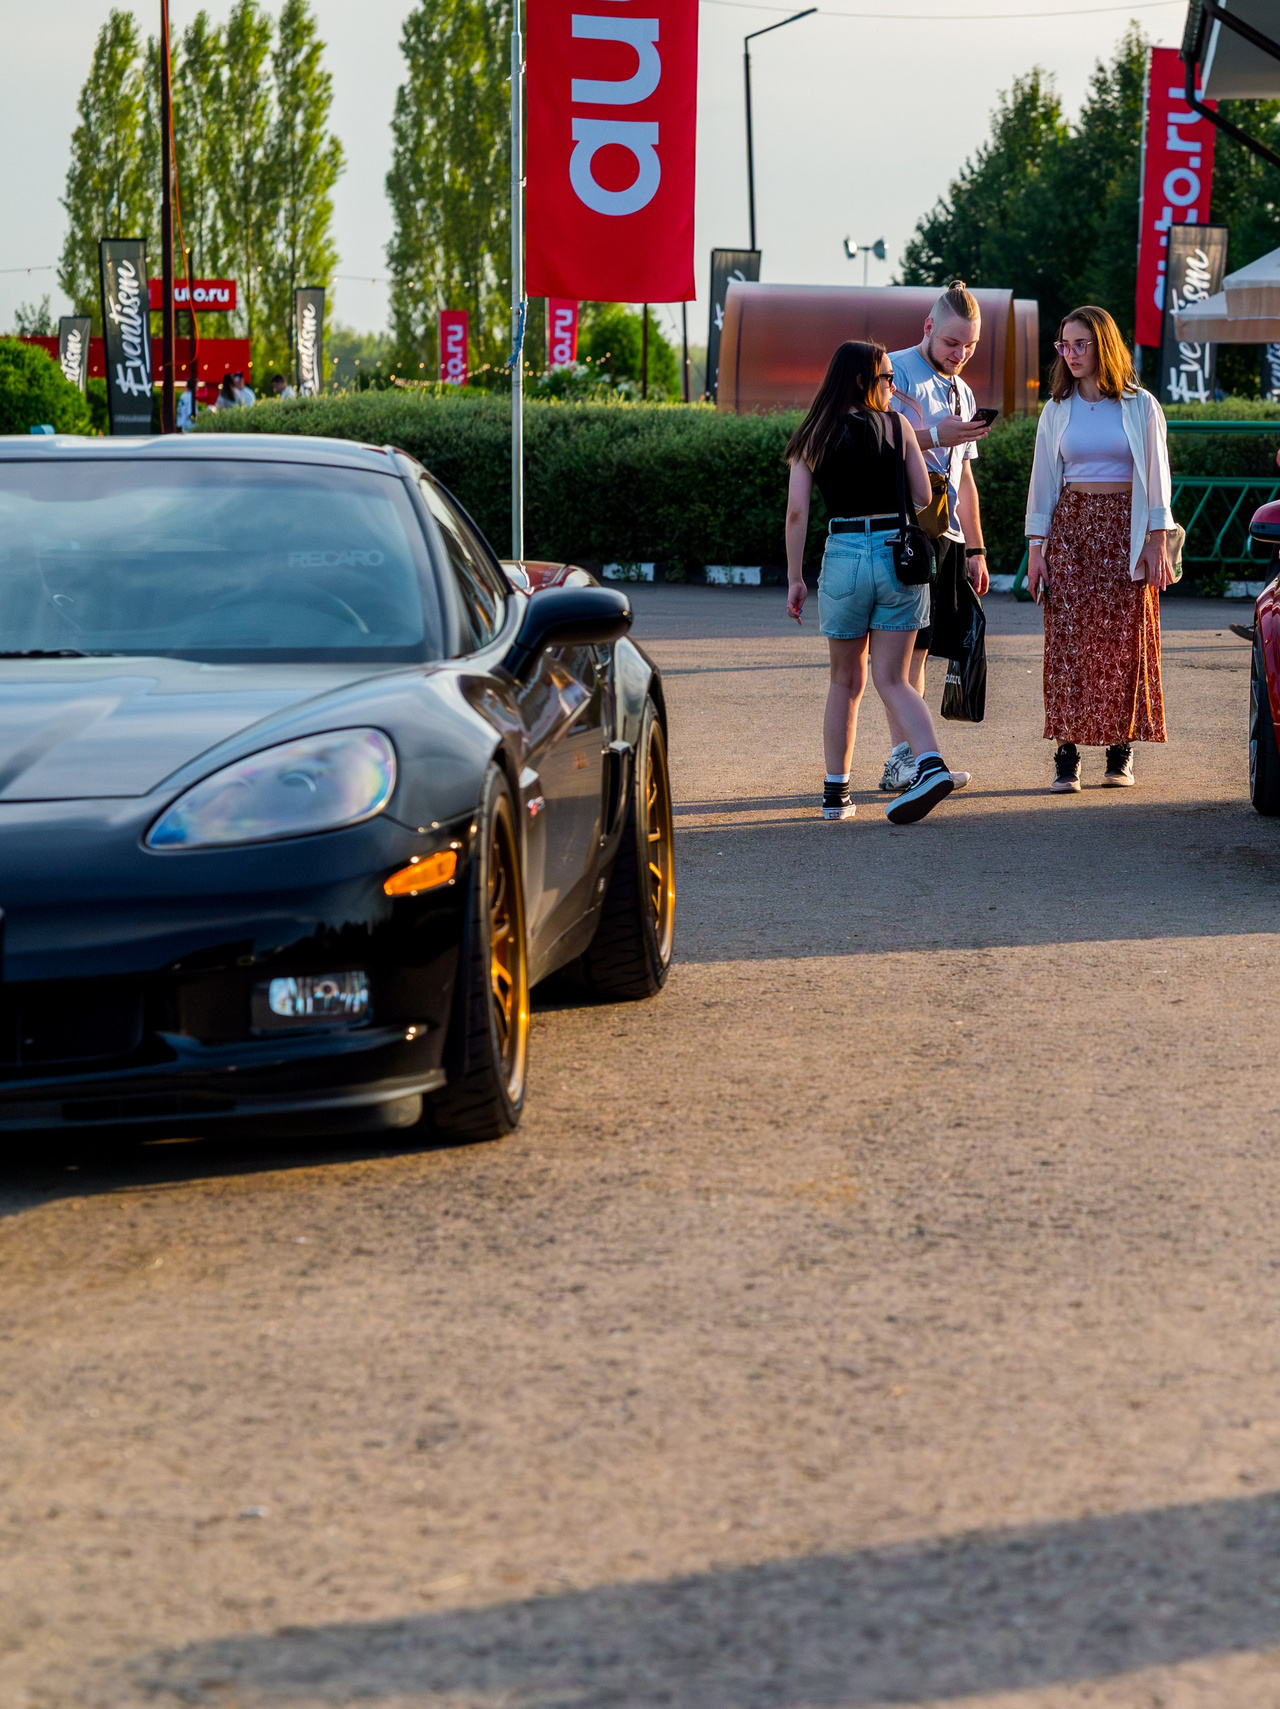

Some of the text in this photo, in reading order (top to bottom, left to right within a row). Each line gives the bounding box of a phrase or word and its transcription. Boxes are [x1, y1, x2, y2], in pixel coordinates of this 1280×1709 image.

[569, 0, 662, 216] au
[110, 259, 152, 397] Eventism
[288, 550, 384, 568] RECARO
